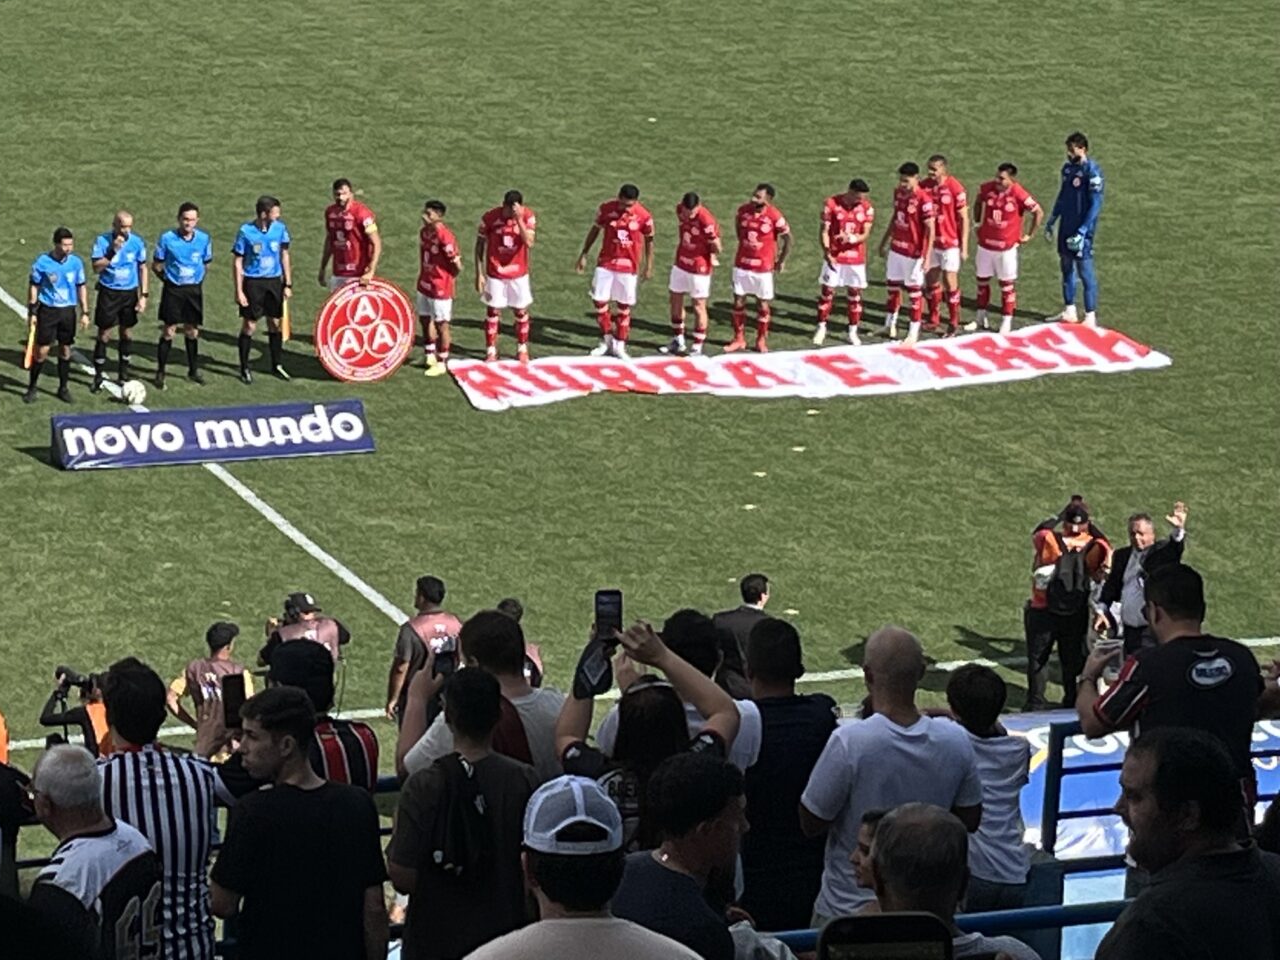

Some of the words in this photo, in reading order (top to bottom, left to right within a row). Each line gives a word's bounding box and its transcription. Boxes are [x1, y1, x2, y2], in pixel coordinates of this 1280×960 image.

[353, 296, 377, 323] A
[339, 329, 361, 356] A
[372, 324, 395, 351] A
[802, 352, 901, 387] E
[62, 422, 184, 456] novo
[194, 405, 364, 450] mundo
